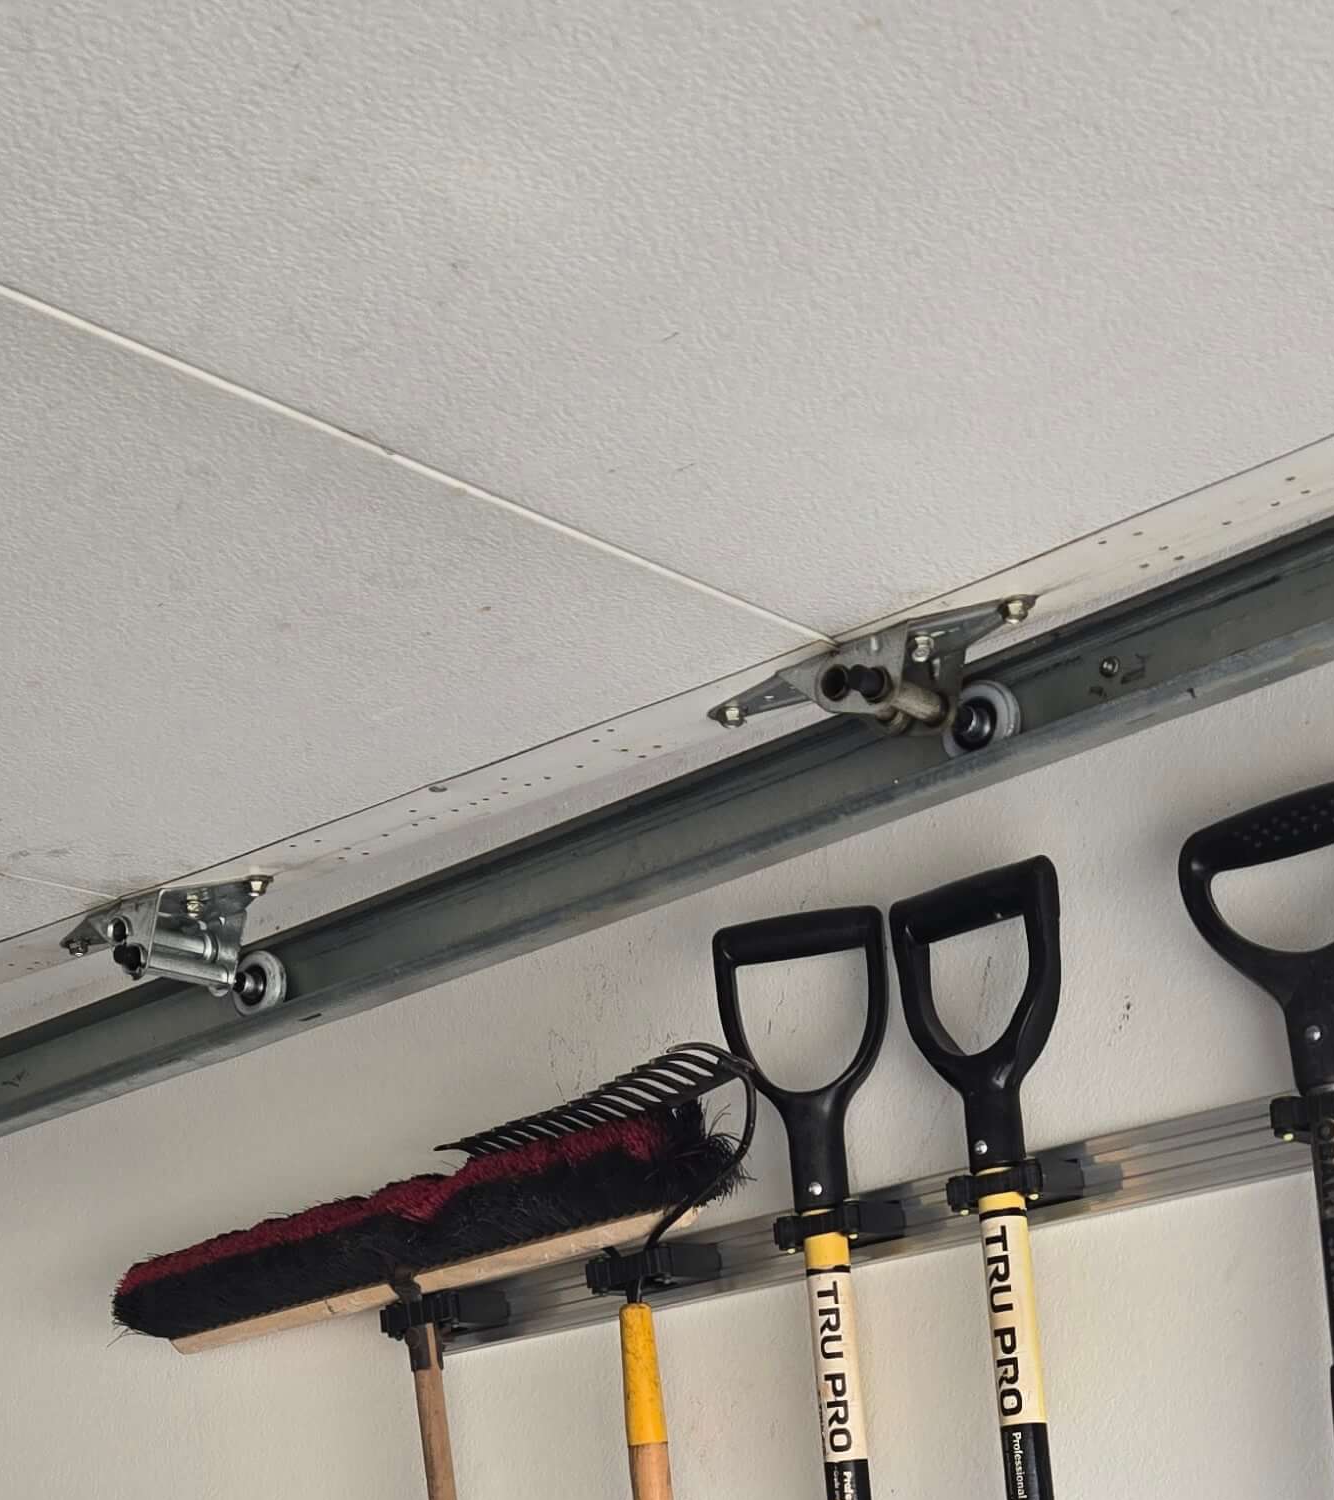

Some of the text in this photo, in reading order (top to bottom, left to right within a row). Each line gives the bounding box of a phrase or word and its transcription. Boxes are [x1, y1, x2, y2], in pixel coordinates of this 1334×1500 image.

[817, 1280, 854, 1454] TRU PRO
[984, 1225, 1024, 1418] TRU PRO
[1011, 1431, 1027, 1499] Professional
